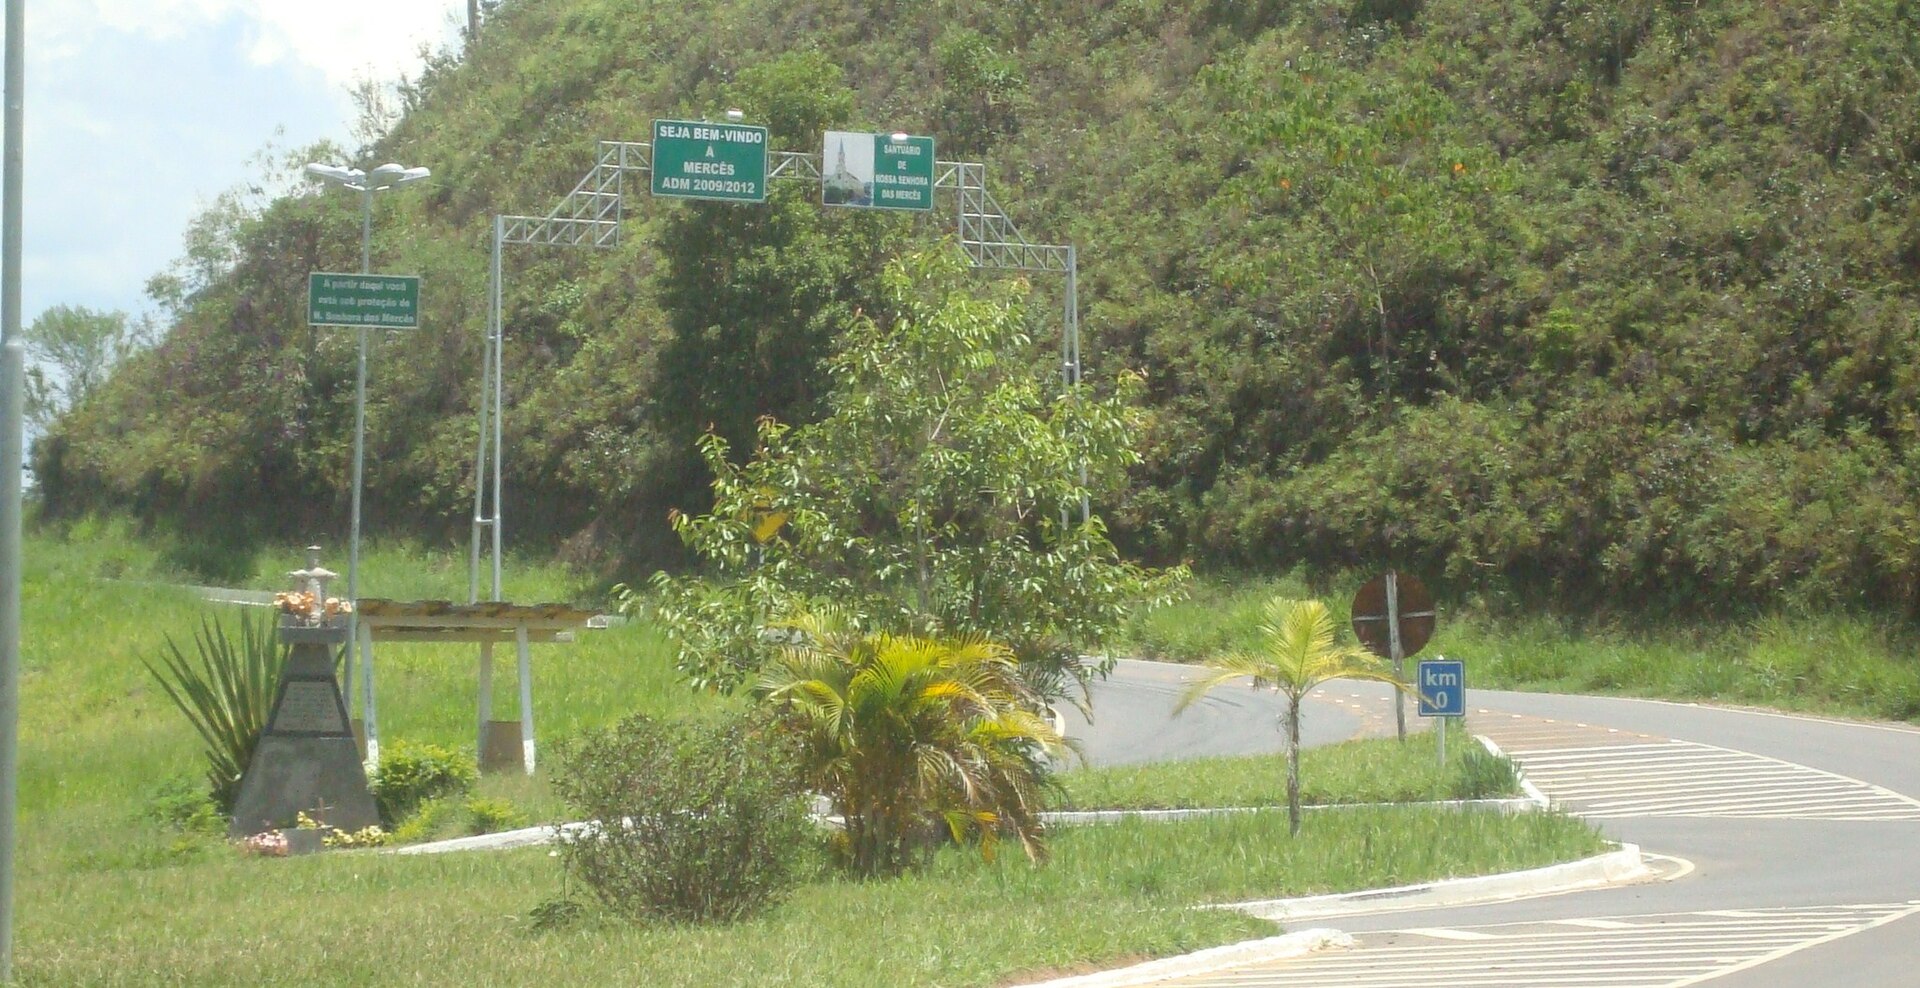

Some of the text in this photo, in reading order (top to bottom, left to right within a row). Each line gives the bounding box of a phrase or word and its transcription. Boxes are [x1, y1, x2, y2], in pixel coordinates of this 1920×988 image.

[660, 125, 762, 144] SEJA BEM-VINDO
[705, 146, 715, 158] A
[683, 161, 735, 175] MERCÊS
[898, 160, 907, 170] DE
[662, 177, 755, 194] ADM 2009/2012
[875, 174, 898, 184] NOSSA
[882, 189, 895, 199] DAS
[1426, 668, 1457, 686] km
[1436, 691, 1448, 708] 0
